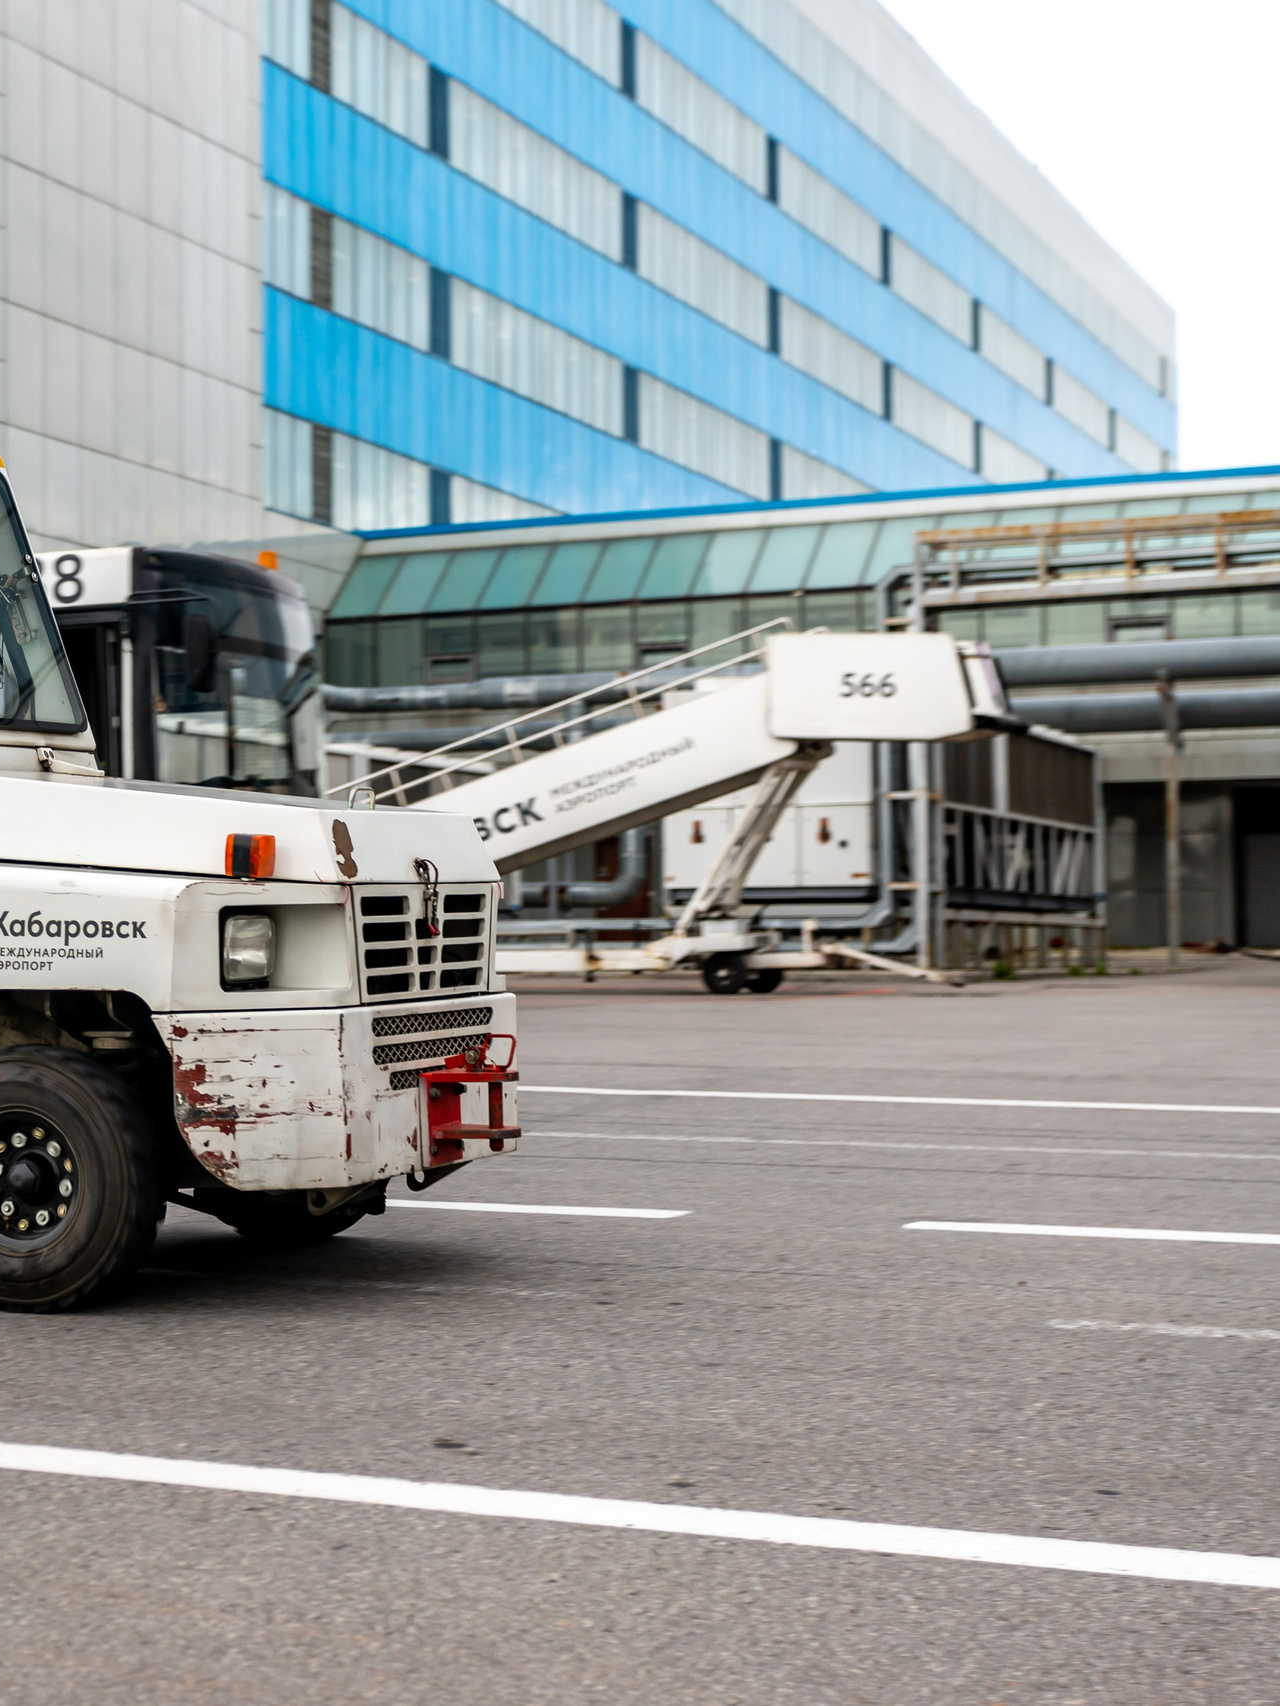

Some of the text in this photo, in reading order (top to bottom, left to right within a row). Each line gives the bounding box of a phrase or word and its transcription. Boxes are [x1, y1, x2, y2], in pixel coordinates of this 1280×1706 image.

[838, 672, 898, 698] 566
[549, 737, 695, 798] МЕЖДУНАРОДНЫЙ
[555, 775, 637, 813] АЭРОПОРТ
